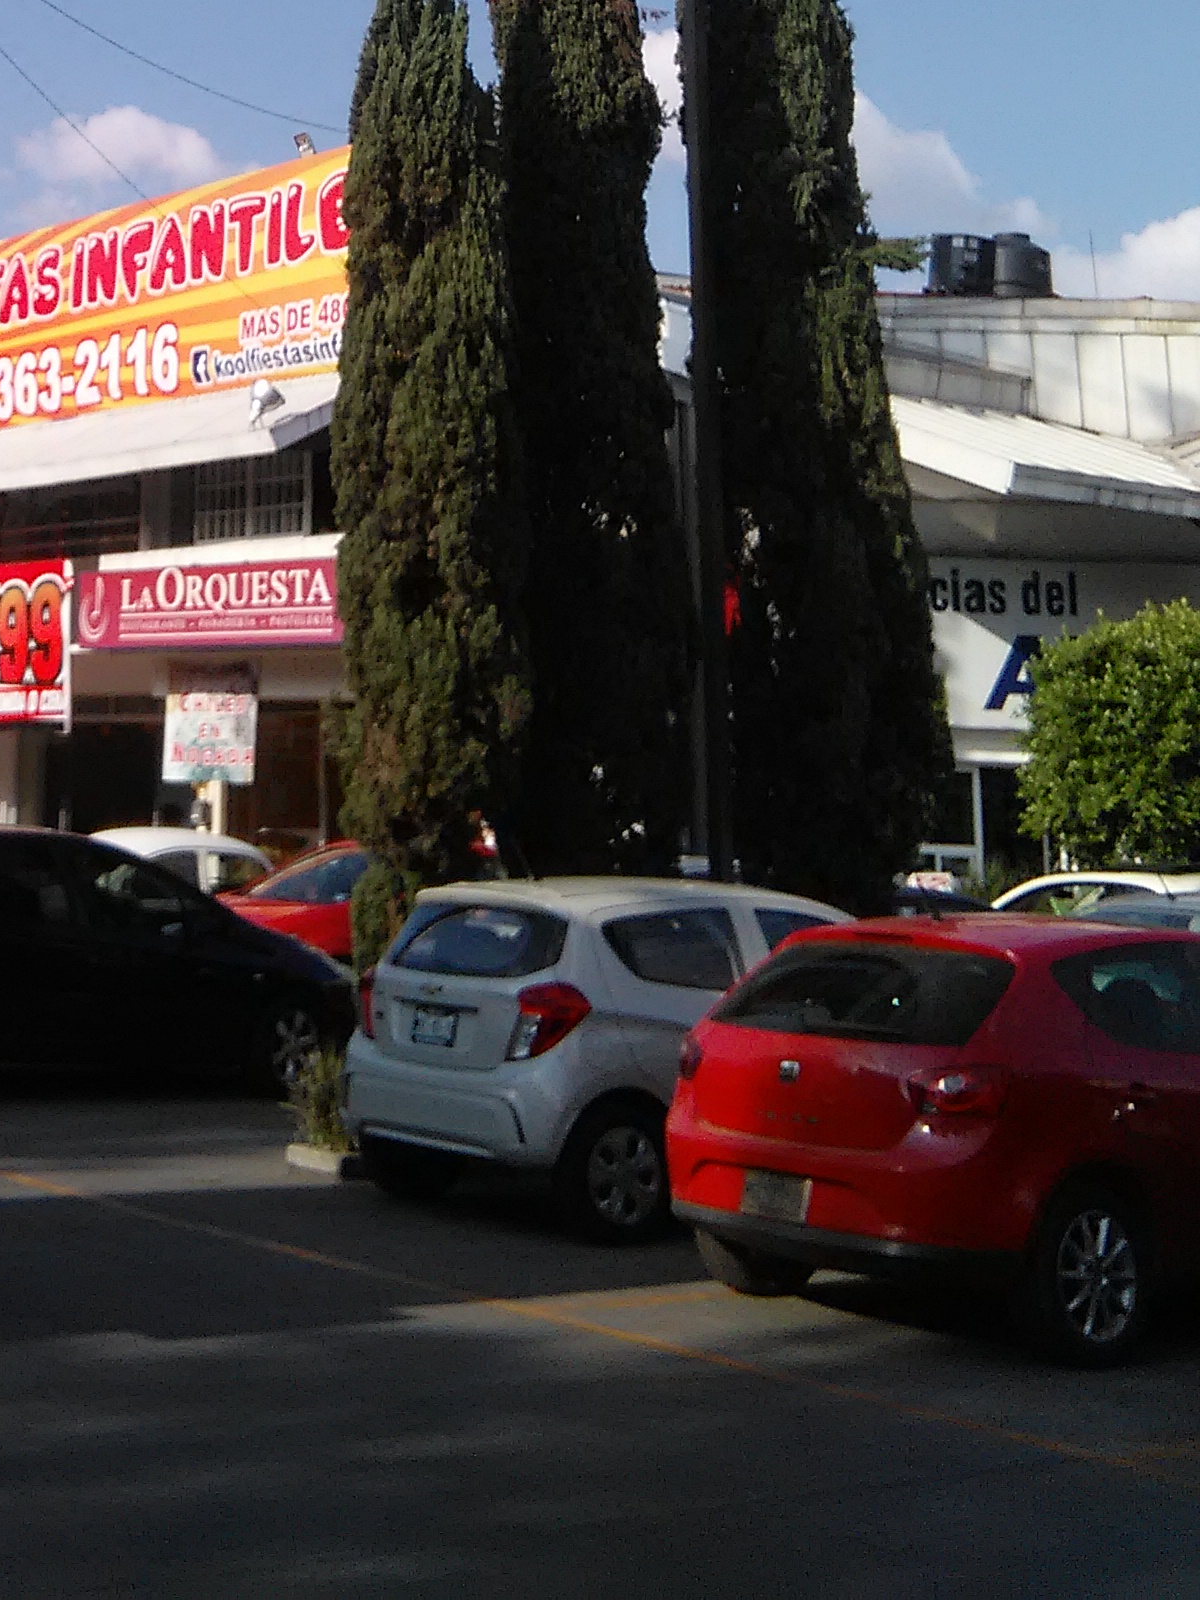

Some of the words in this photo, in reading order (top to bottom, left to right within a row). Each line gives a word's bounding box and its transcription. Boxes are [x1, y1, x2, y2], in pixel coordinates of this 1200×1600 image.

[240, 311, 280, 340] MAS
[286, 304, 311, 332] DE
[156, 566, 333, 613] ORQUESTA
[1022, 570, 1078, 616] del
